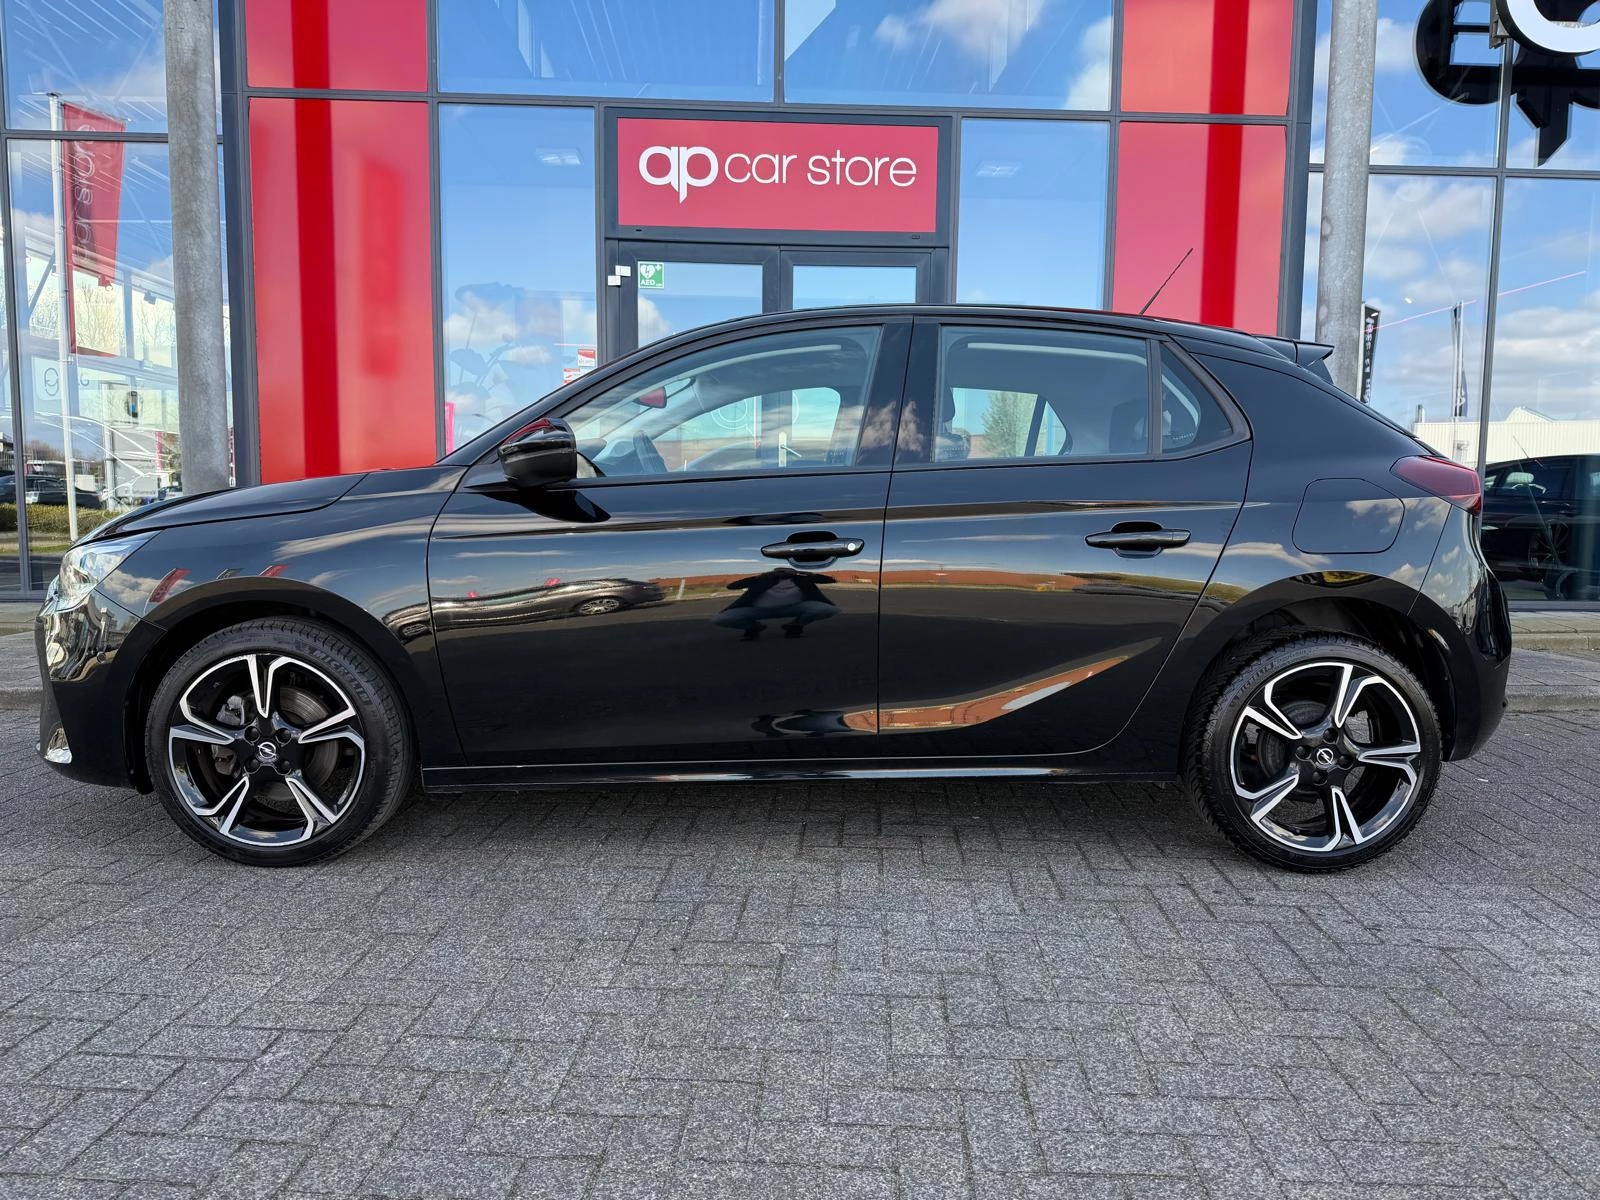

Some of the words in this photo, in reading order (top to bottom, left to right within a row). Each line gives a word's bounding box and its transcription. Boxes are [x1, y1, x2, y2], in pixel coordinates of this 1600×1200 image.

[638, 145, 719, 204] ap
[724, 153, 798, 183] car
[806, 149, 917, 187] store
[312, 649, 370, 702] MICHELIN
